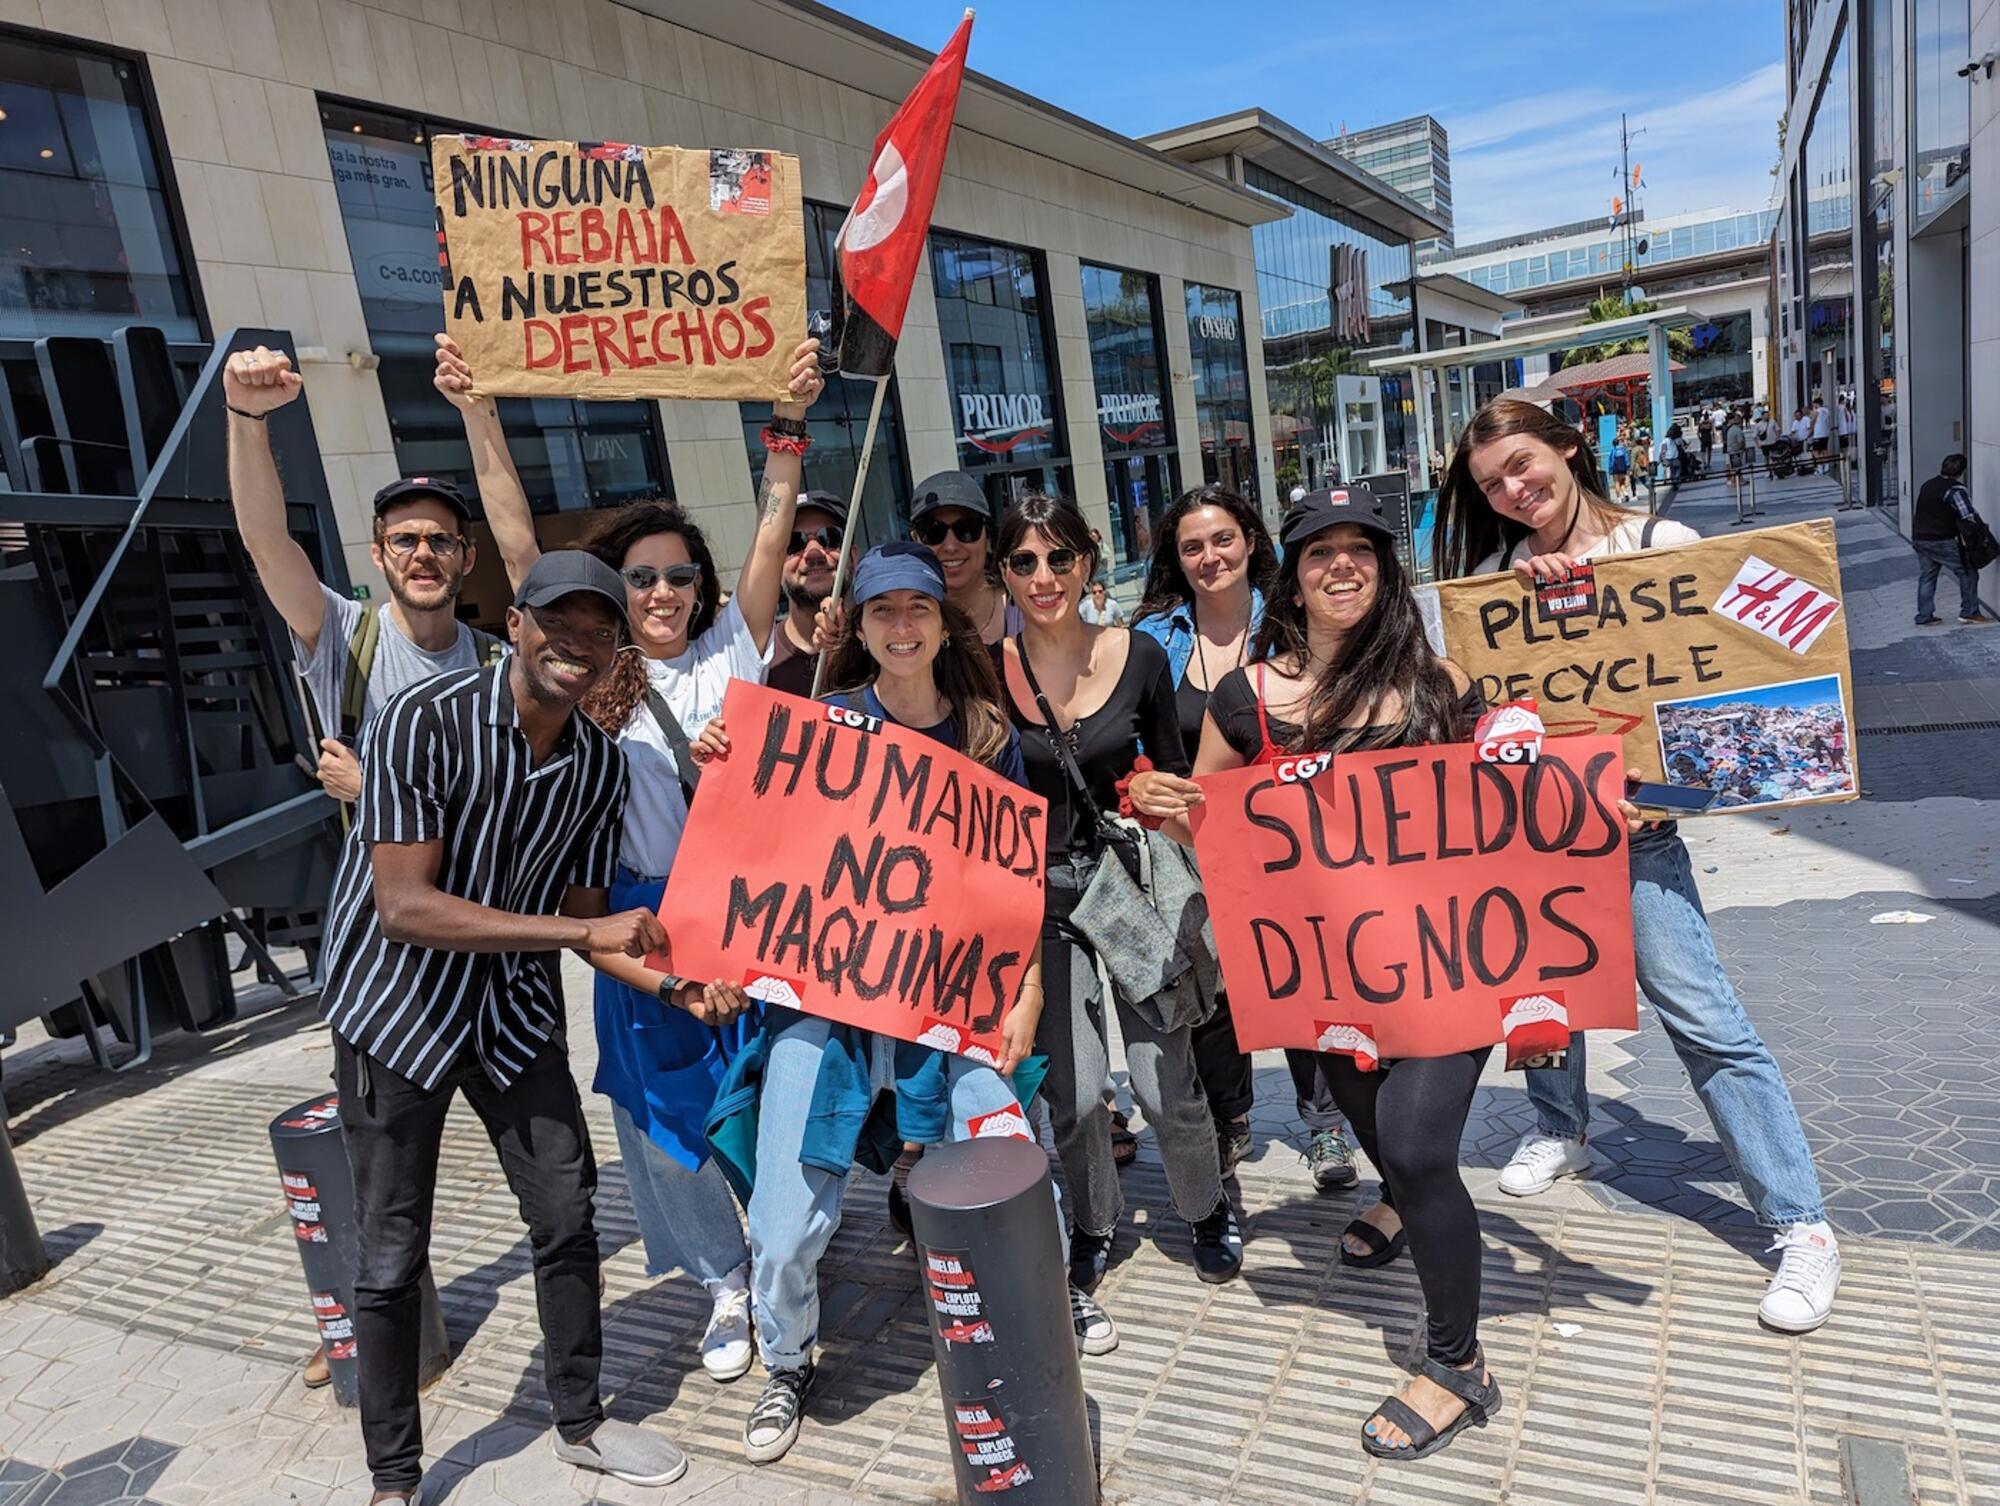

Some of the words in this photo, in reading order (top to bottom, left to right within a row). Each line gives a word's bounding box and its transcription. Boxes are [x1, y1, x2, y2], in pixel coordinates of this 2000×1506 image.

[354, 168, 381, 185] més
[382, 174, 413, 189] gran.
[360, 152, 397, 171] nostra
[450, 151, 655, 217] NINGUNA
[516, 205, 695, 269] REBAJA
[454, 275, 484, 323] A
[502, 260, 740, 321] NUESTROS
[523, 296, 776, 376] DERECHOS
[1200, 314, 1236, 341] OYSHO
[960, 393, 1044, 430] PRIMOR
[1101, 393, 1160, 423] PRIMOR
[1722, 568, 1841, 651] H&M
[827, 705, 883, 732] CGT
[1277, 752, 1334, 784] CGT
[1478, 741, 1541, 764] CGT
[1244, 752, 1622, 874] SUELDOS
[822, 831, 933, 916] NO
[721, 875, 1020, 1034] MAQUINAS
[1250, 886, 1599, 1003] DIGNOS
